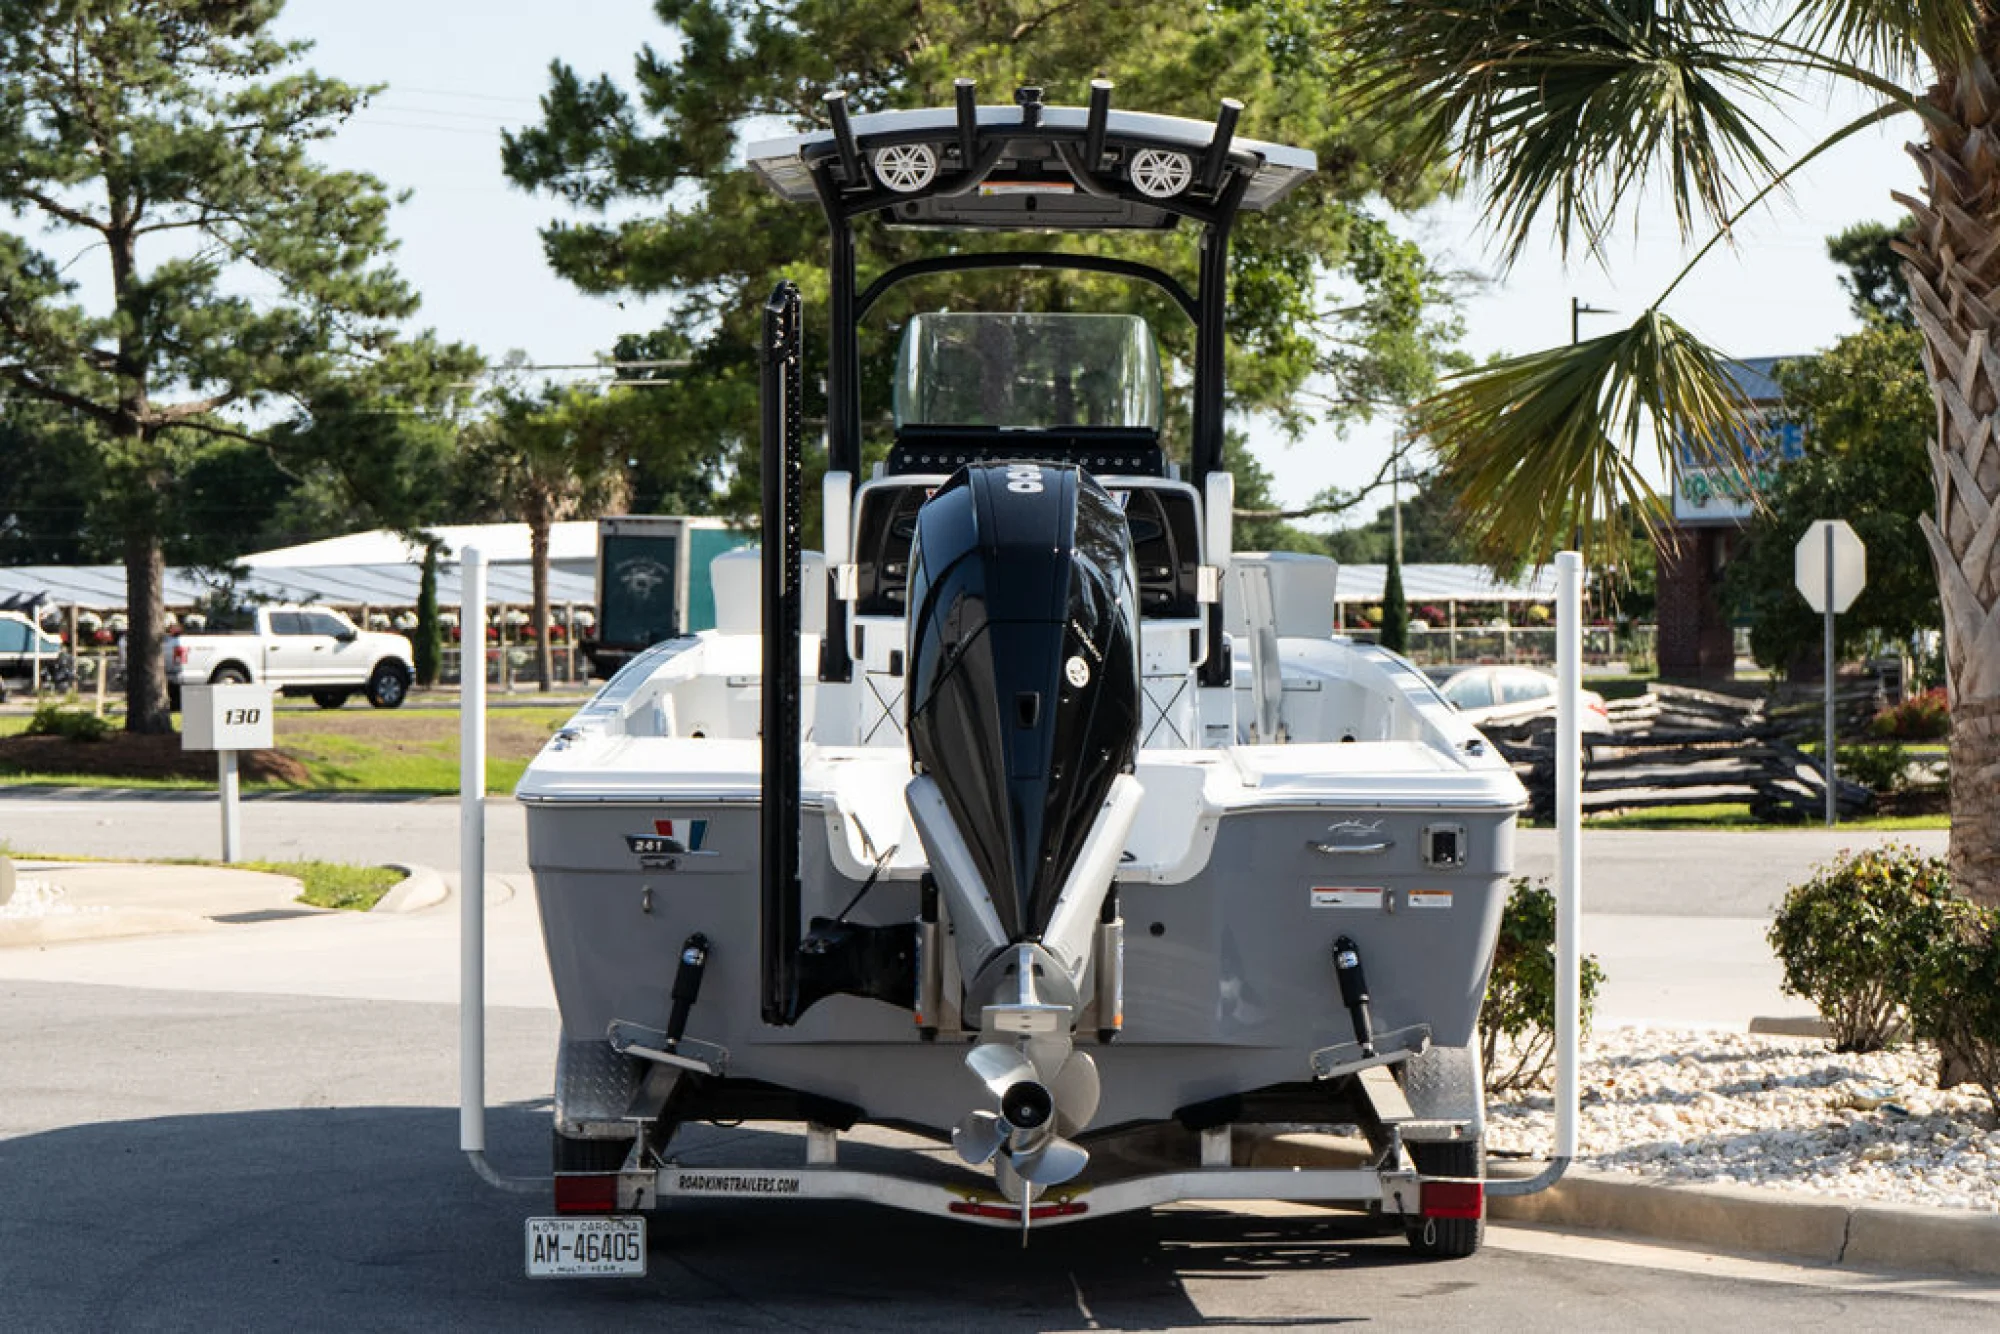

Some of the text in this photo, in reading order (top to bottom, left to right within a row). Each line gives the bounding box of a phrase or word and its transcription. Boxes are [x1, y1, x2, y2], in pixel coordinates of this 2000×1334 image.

[226, 708, 261, 726] 130
[635, 841, 662, 852] 241
[679, 1175, 800, 1193] ROADKINGTRAILERS.COM
[532, 1222, 638, 1233] NORTH CAROLINA
[533, 1232, 640, 1264] AM-46405
